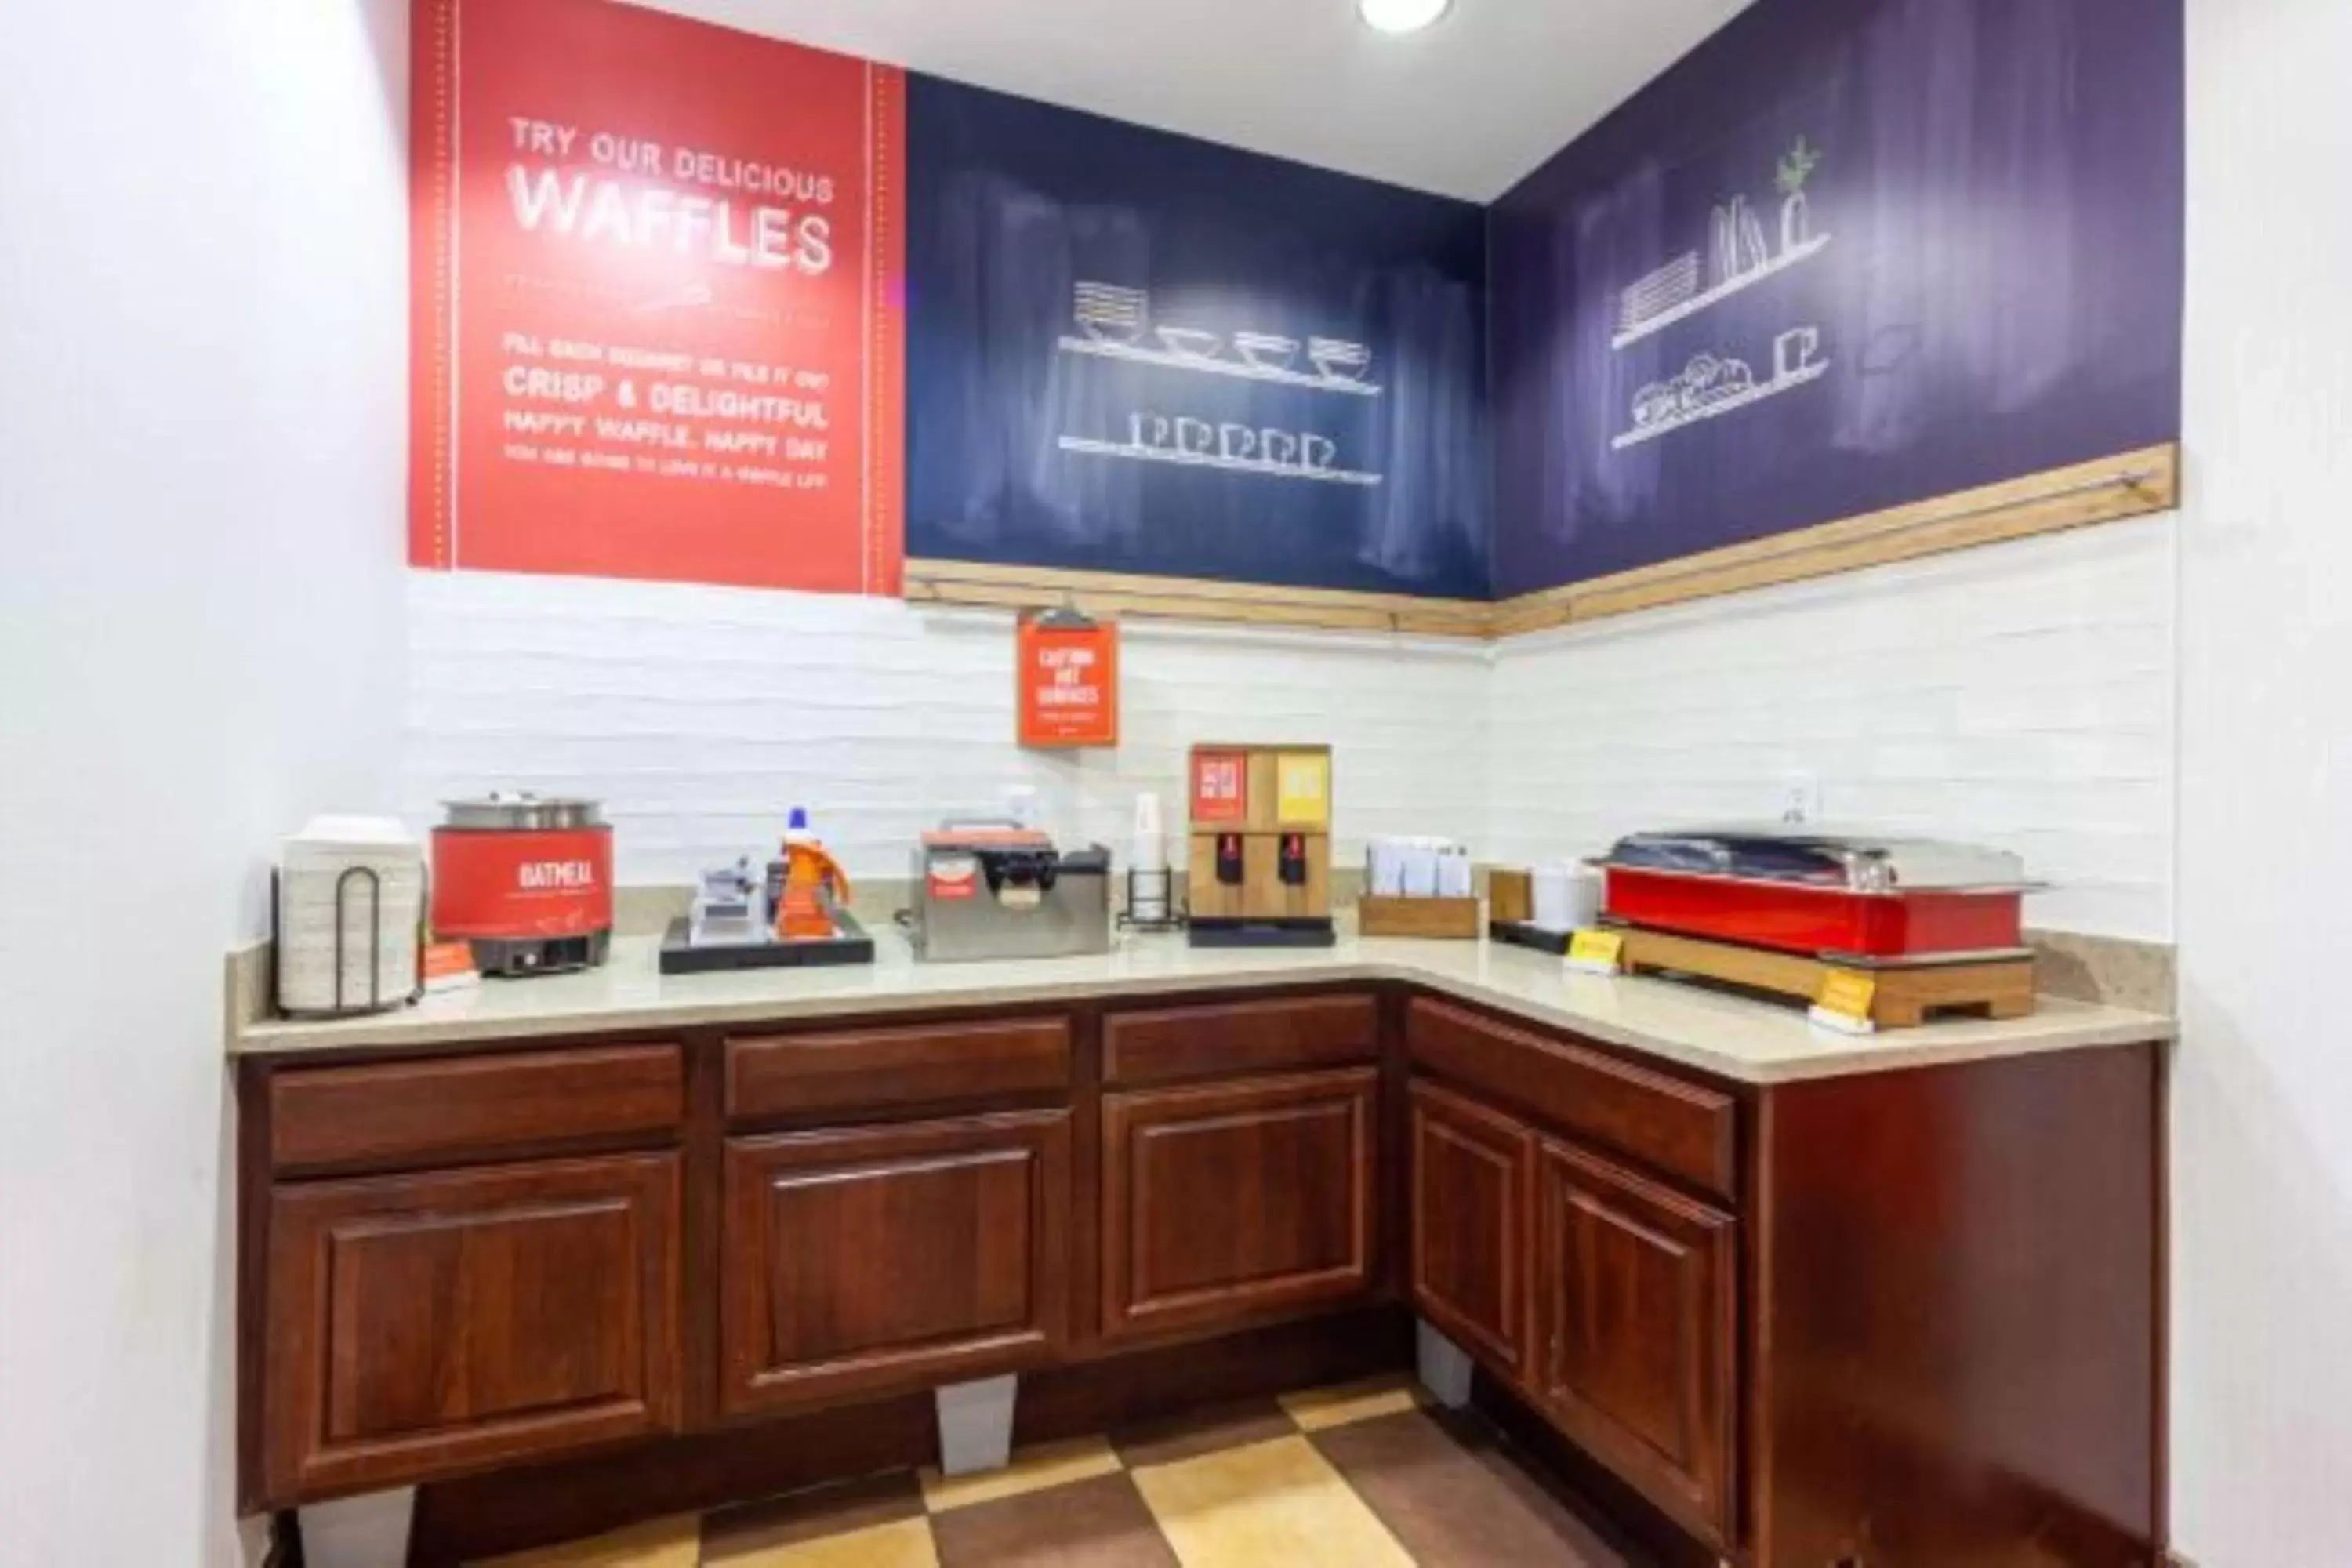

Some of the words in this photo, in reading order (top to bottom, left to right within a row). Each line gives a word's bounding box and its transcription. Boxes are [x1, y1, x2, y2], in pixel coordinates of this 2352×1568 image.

[508, 117, 576, 155] TRY
[590, 131, 662, 176] OUR
[673, 146, 836, 204] DELICIOUS
[506, 162, 832, 275] WAFFLES
[503, 365, 605, 403] CRISP
[617, 378, 637, 410] &
[650, 381, 829, 430] DELIGHTFUL
[503, 409, 586, 437] HAPPY
[704, 430, 777, 457] HAPPY
[786, 437, 828, 462] DAY
[518, 859, 595, 887] OATMEAL
